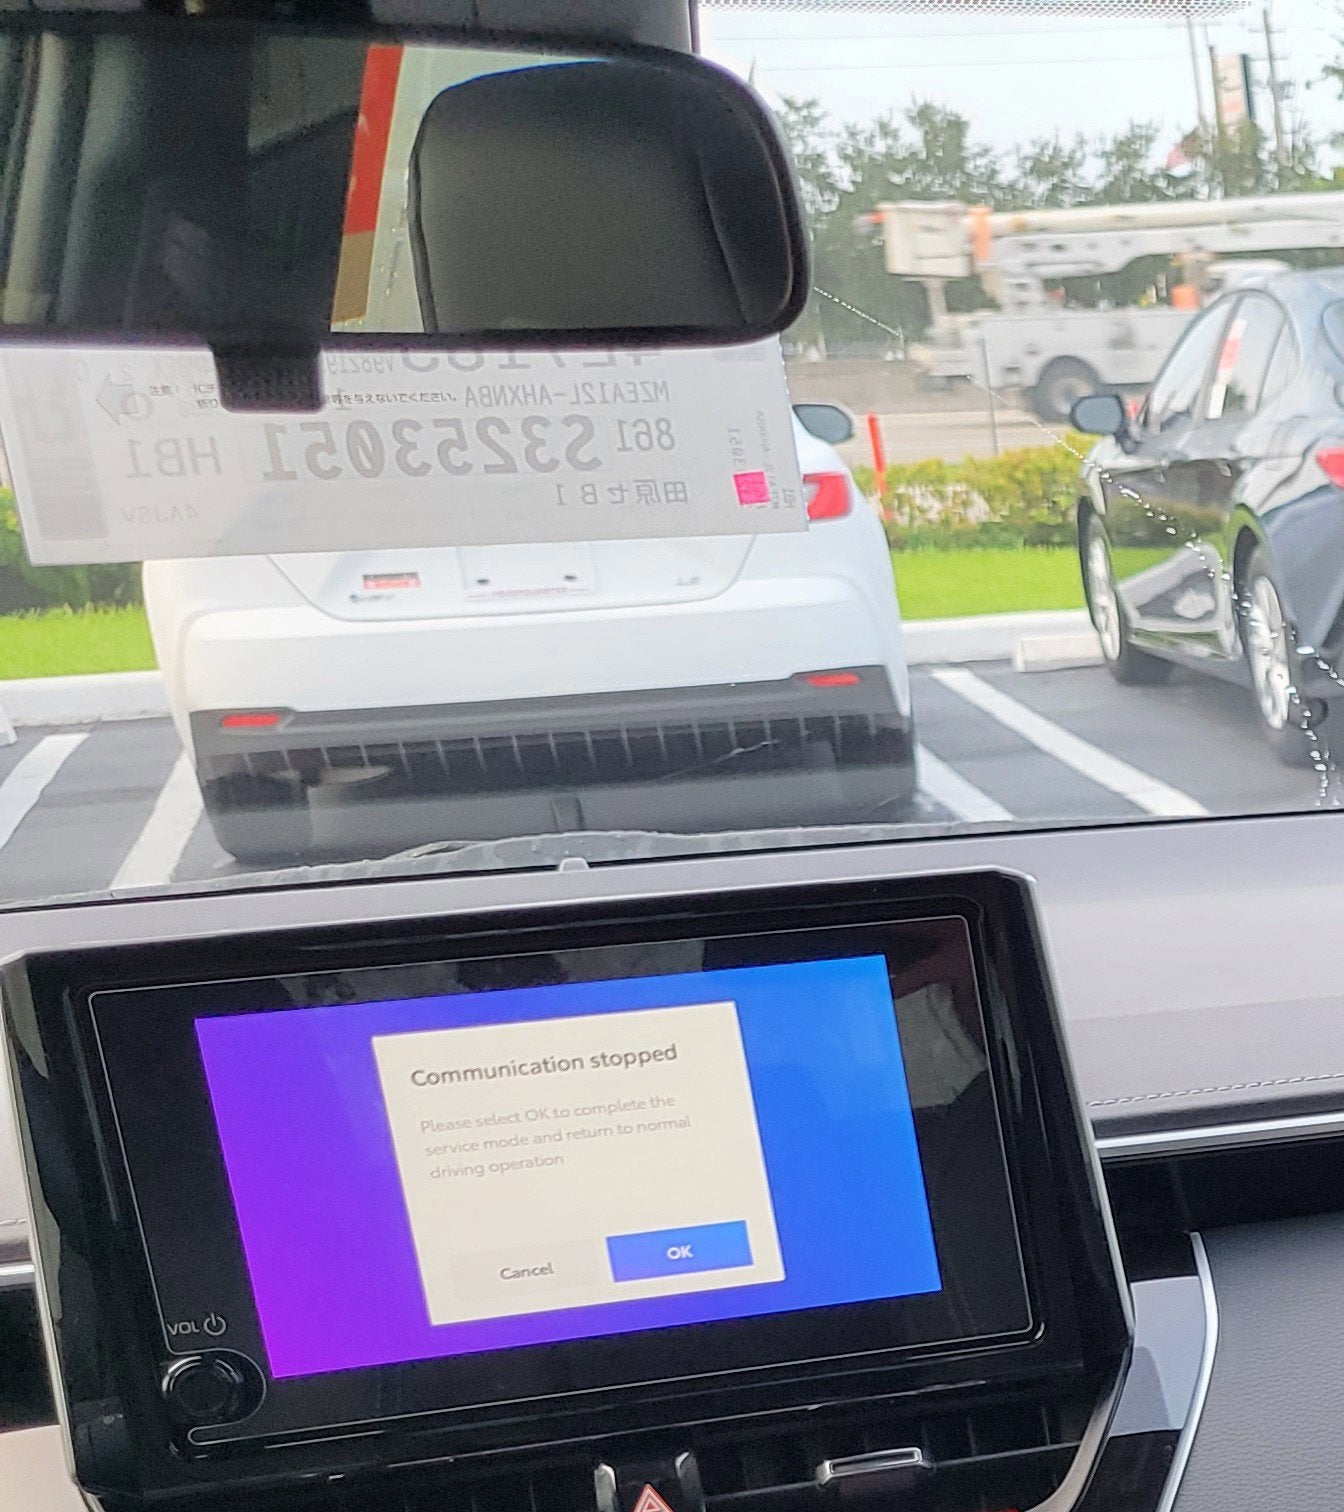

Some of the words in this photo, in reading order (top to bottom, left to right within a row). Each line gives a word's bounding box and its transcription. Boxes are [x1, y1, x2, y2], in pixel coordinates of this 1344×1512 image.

[410, 1053, 586, 1088] Communication
[589, 1043, 679, 1070] stopped
[419, 1116, 474, 1134] Please
[474, 1112, 523, 1129] select
[524, 1107, 551, 1122] OK
[553, 1107, 571, 1119] to
[574, 1098, 648, 1118] complete
[649, 1095, 677, 1109] the
[424, 1138, 480, 1157] service
[482, 1133, 531, 1151] mode
[532, 1129, 564, 1145] and
[565, 1124, 614, 1141] return
[616, 1121, 635, 1136] to
[635, 1114, 693, 1134] normal
[430, 1160, 486, 1181] driving
[488, 1153, 566, 1176] operation
[666, 1244, 695, 1261] OK
[499, 1261, 556, 1281] Cancel
[166, 1321, 201, 1336] VOL
